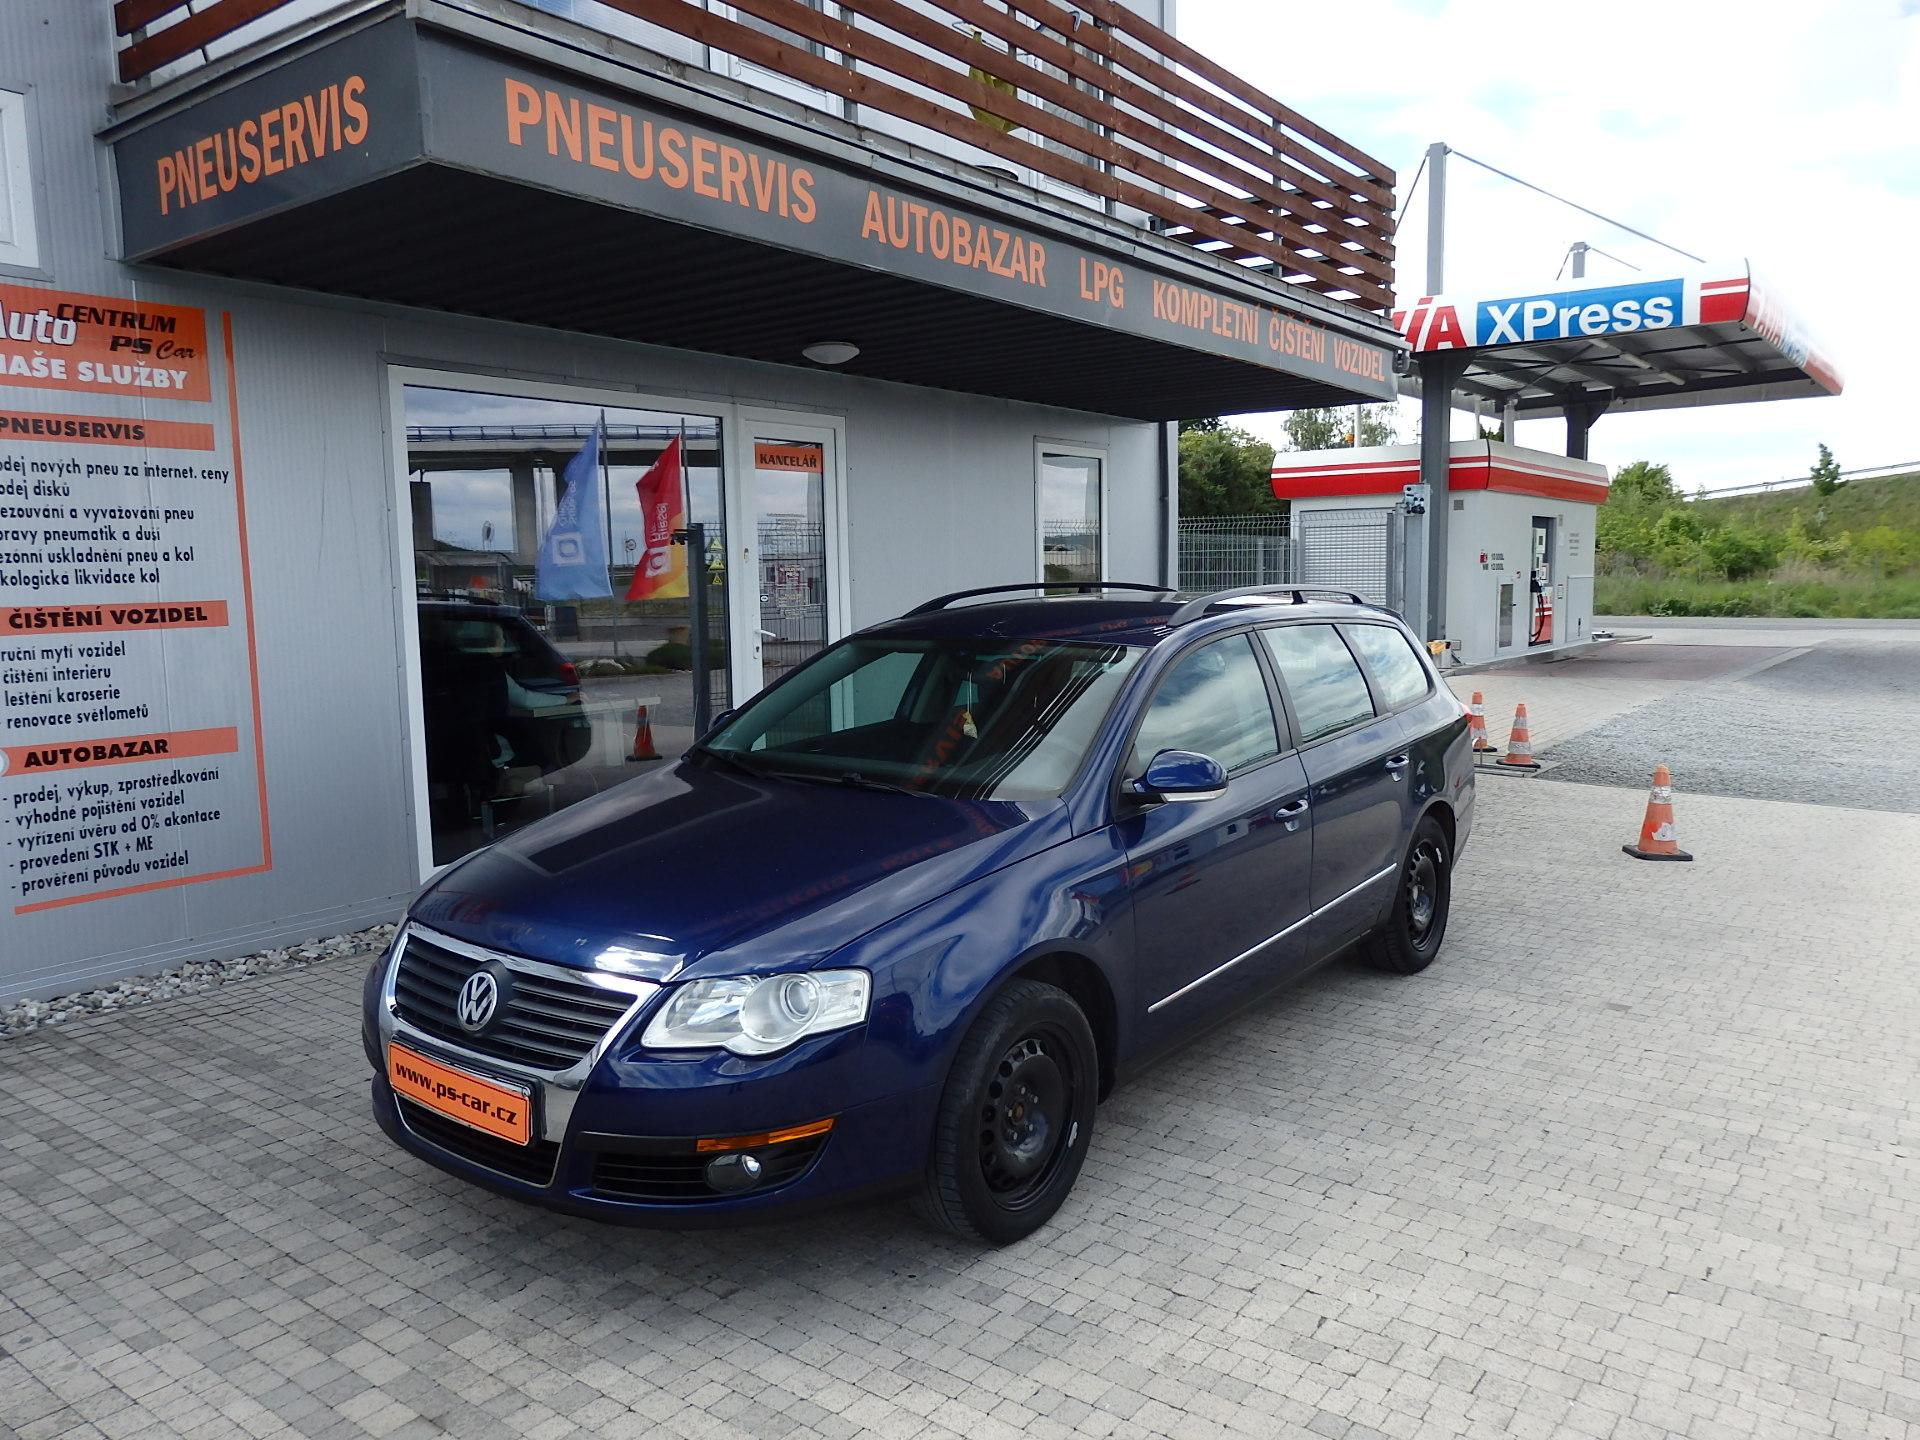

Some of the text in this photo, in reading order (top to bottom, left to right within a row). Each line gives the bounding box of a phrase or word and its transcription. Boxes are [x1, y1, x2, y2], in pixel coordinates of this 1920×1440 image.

[158, 75, 370, 216] PNEUSERVIS
[504, 77, 1386, 382] PNEUSERVIS AUTOBAZAR LPG KOMPLETNÍ ČIŠTĚNÍ VOZIDEL
[56, 303, 177, 334] CENTRUM
[1484, 296, 1674, 347] XPress
[109, 335, 197, 360] PS Car
[77, 360, 188, 390] SLUŽBY
[31, 457, 82, 478] nových
[86, 463, 119, 479] pneu
[123, 465, 140, 477] za
[143, 461, 198, 479] internet.
[201, 469, 229, 484] ceny
[759, 452, 817, 469] KANCELÁŘ
[69, 508, 78, 519] a
[83, 505, 160, 524] vyvažování
[164, 509, 195, 524] pneu
[43, 525, 118, 546] pneumatik
[122, 530, 130, 541] a
[135, 525, 161, 541] duší
[47, 546, 123, 563] uskladnění
[126, 551, 158, 566] pneu
[162, 551, 170, 562] a
[174, 546, 195, 562] kol
[74, 568, 135, 585] likvidace
[139, 567, 160, 584] kol
[8, 605, 208, 629] ČIŠTĚNÍ VOZIDEL
[41, 643, 73, 663] mytí
[77, 640, 126, 658] vozidel
[3, 663, 111, 684] čištění interiéru
[4, 684, 121, 707] leštění karoserie
[6, 704, 149, 729] renovace světlometů
[24, 738, 169, 768] AUTOBAZAR
[13, 766, 220, 809] prodej, výkup, zprostředkování
[15, 789, 185, 829] výhodné pojištění vozidel
[17, 809, 221, 851] vyřízení úvěru od 0% akontace
[20, 846, 90, 875] provedení
[93, 840, 120, 859] STK
[136, 835, 154, 852] ME
[22, 849, 189, 896] prověření původu vozidel
[395, 1062, 518, 1126] www.ps-car.cz
